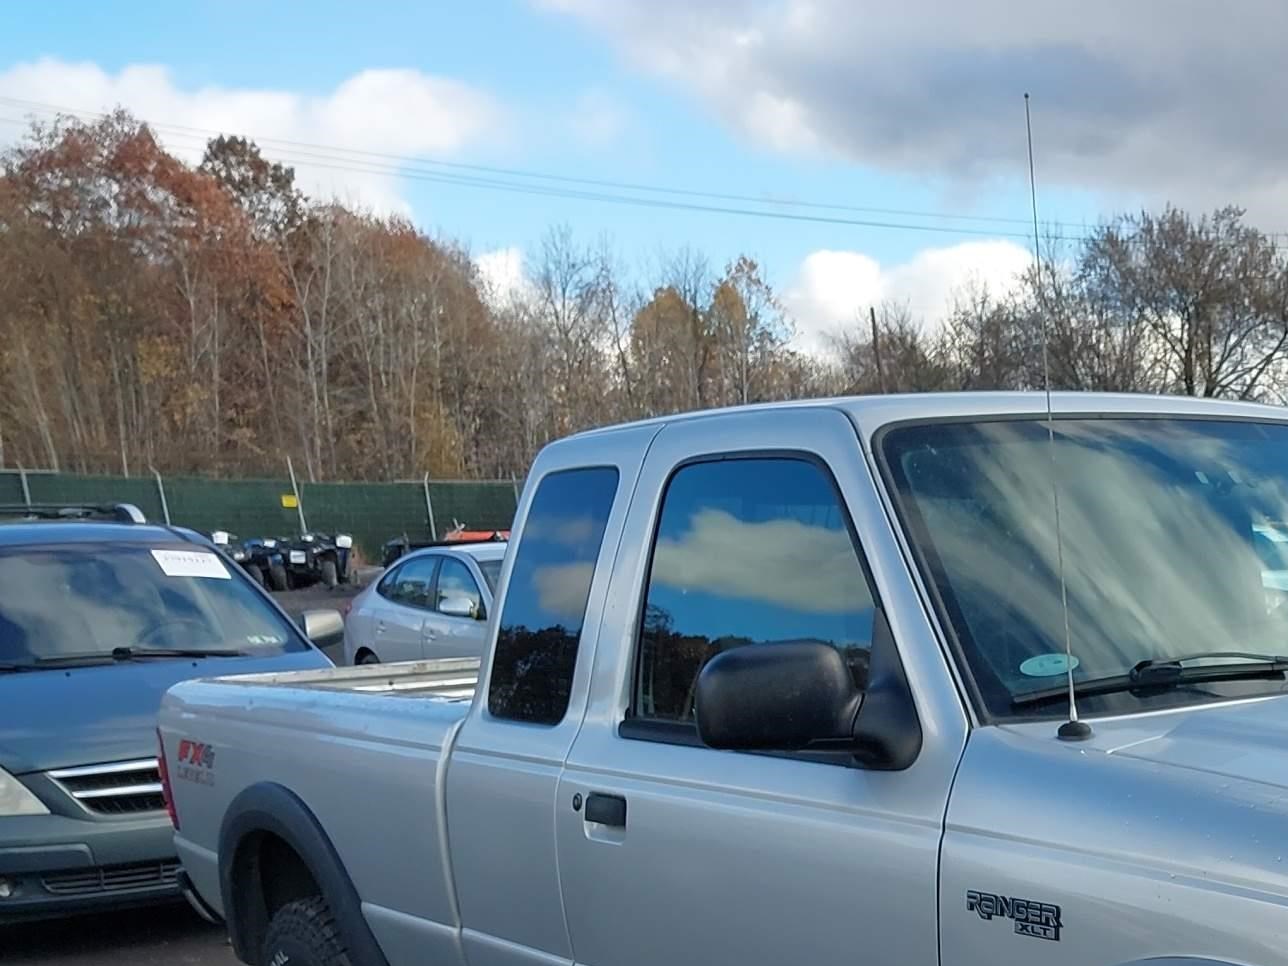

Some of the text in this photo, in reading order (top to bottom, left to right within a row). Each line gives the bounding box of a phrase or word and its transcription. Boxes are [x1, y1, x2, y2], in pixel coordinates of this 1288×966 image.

[178, 739, 215, 769] FX4
[967, 890, 1063, 928] RANGER
[1018, 922, 1055, 938] XLT
